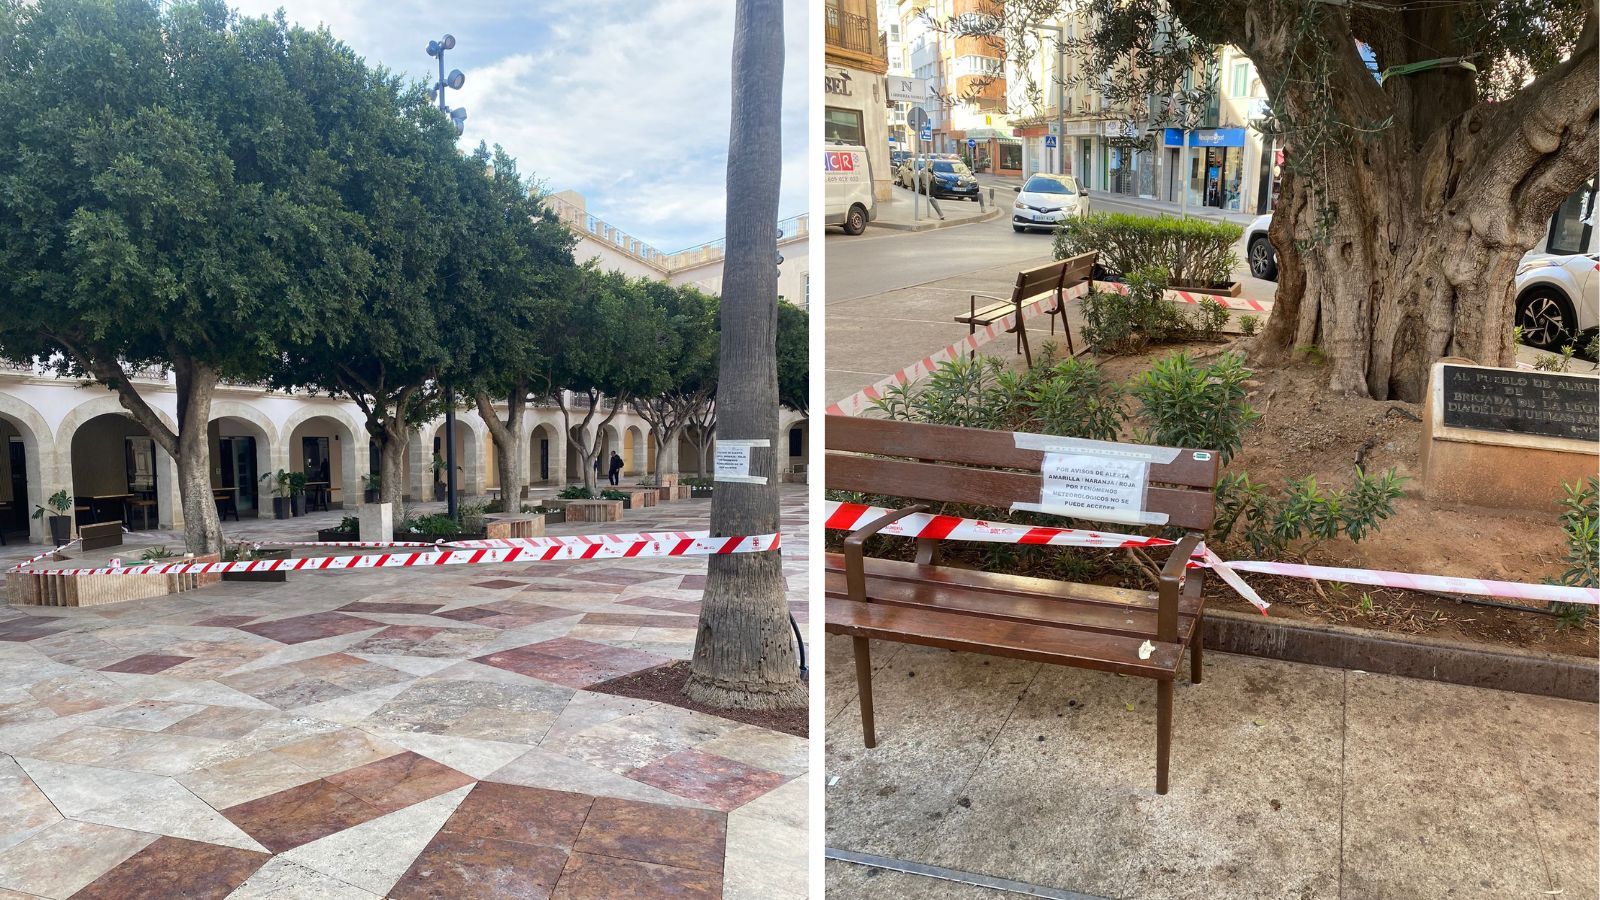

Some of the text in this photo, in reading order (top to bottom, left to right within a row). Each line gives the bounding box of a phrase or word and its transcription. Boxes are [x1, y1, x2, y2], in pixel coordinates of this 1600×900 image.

[901, 81, 912, 92] N
[1533, 378, 1552, 389] DE
[1453, 392, 1513, 407] BRIGADA
[1542, 390, 1560, 400] LA
[1048, 474, 1080, 482] AMARILLA
[1085, 478, 1115, 486] NARANJA
